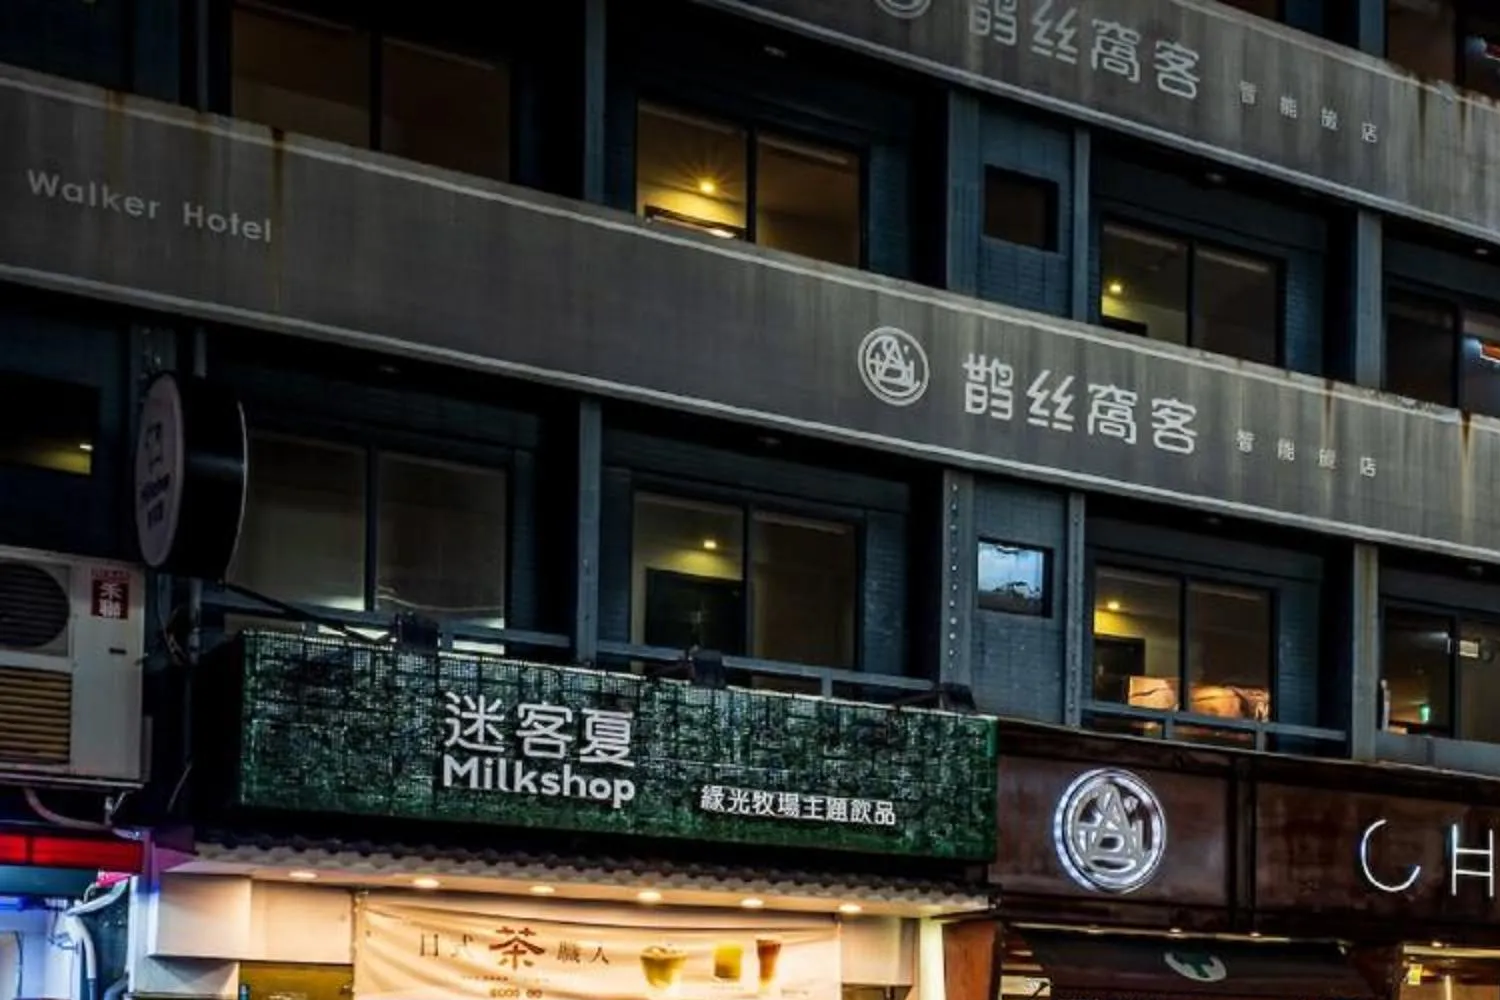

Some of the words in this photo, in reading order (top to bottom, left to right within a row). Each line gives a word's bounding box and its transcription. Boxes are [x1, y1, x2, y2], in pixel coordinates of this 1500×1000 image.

[27, 168, 161, 219] Walker
[183, 201, 272, 243] Hotel
[444, 690, 636, 768] 迷客夏
[442, 753, 636, 809] Milkshop
[699, 783, 896, 826] 綠光牧場主題飲品
